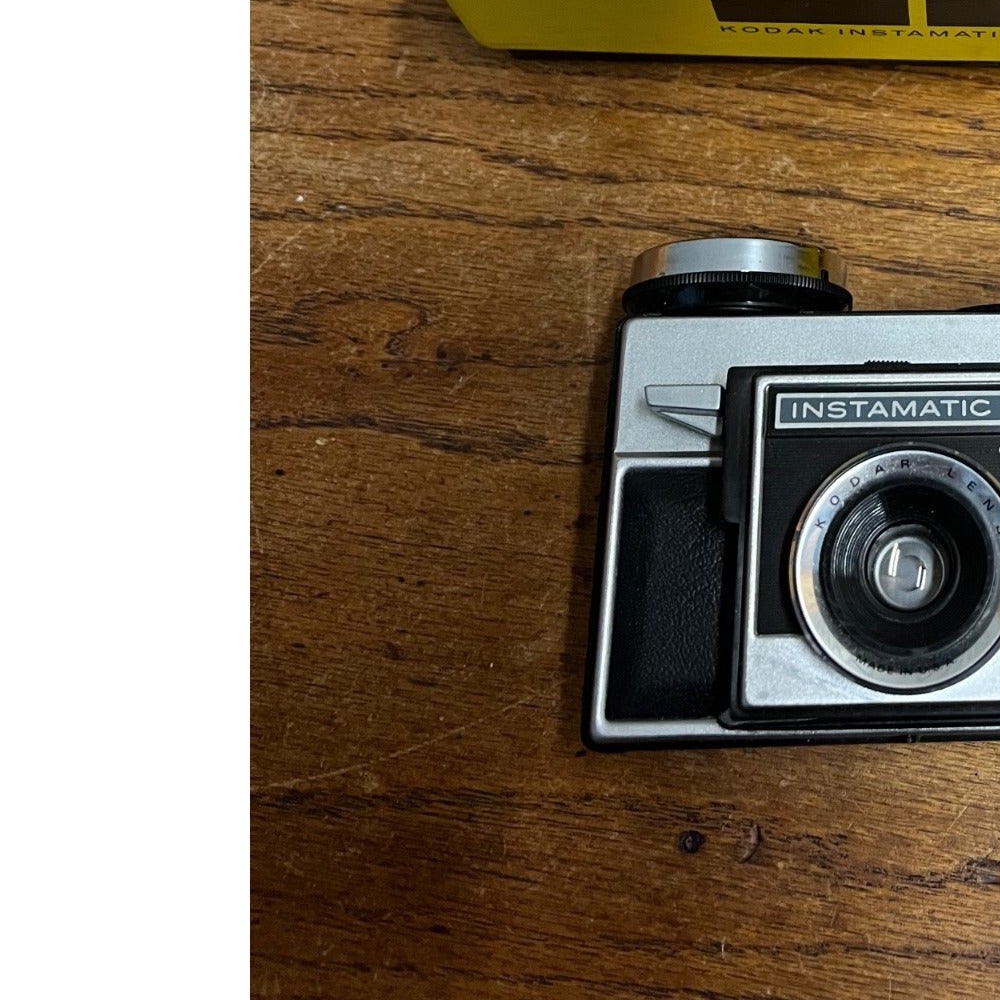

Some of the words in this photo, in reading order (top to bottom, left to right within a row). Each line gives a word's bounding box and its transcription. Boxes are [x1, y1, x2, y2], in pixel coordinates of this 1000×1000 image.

[720, 25, 824, 35] KODAK
[791, 400, 992, 419] INSTAMATIC
[815, 459, 910, 530] KODAR
